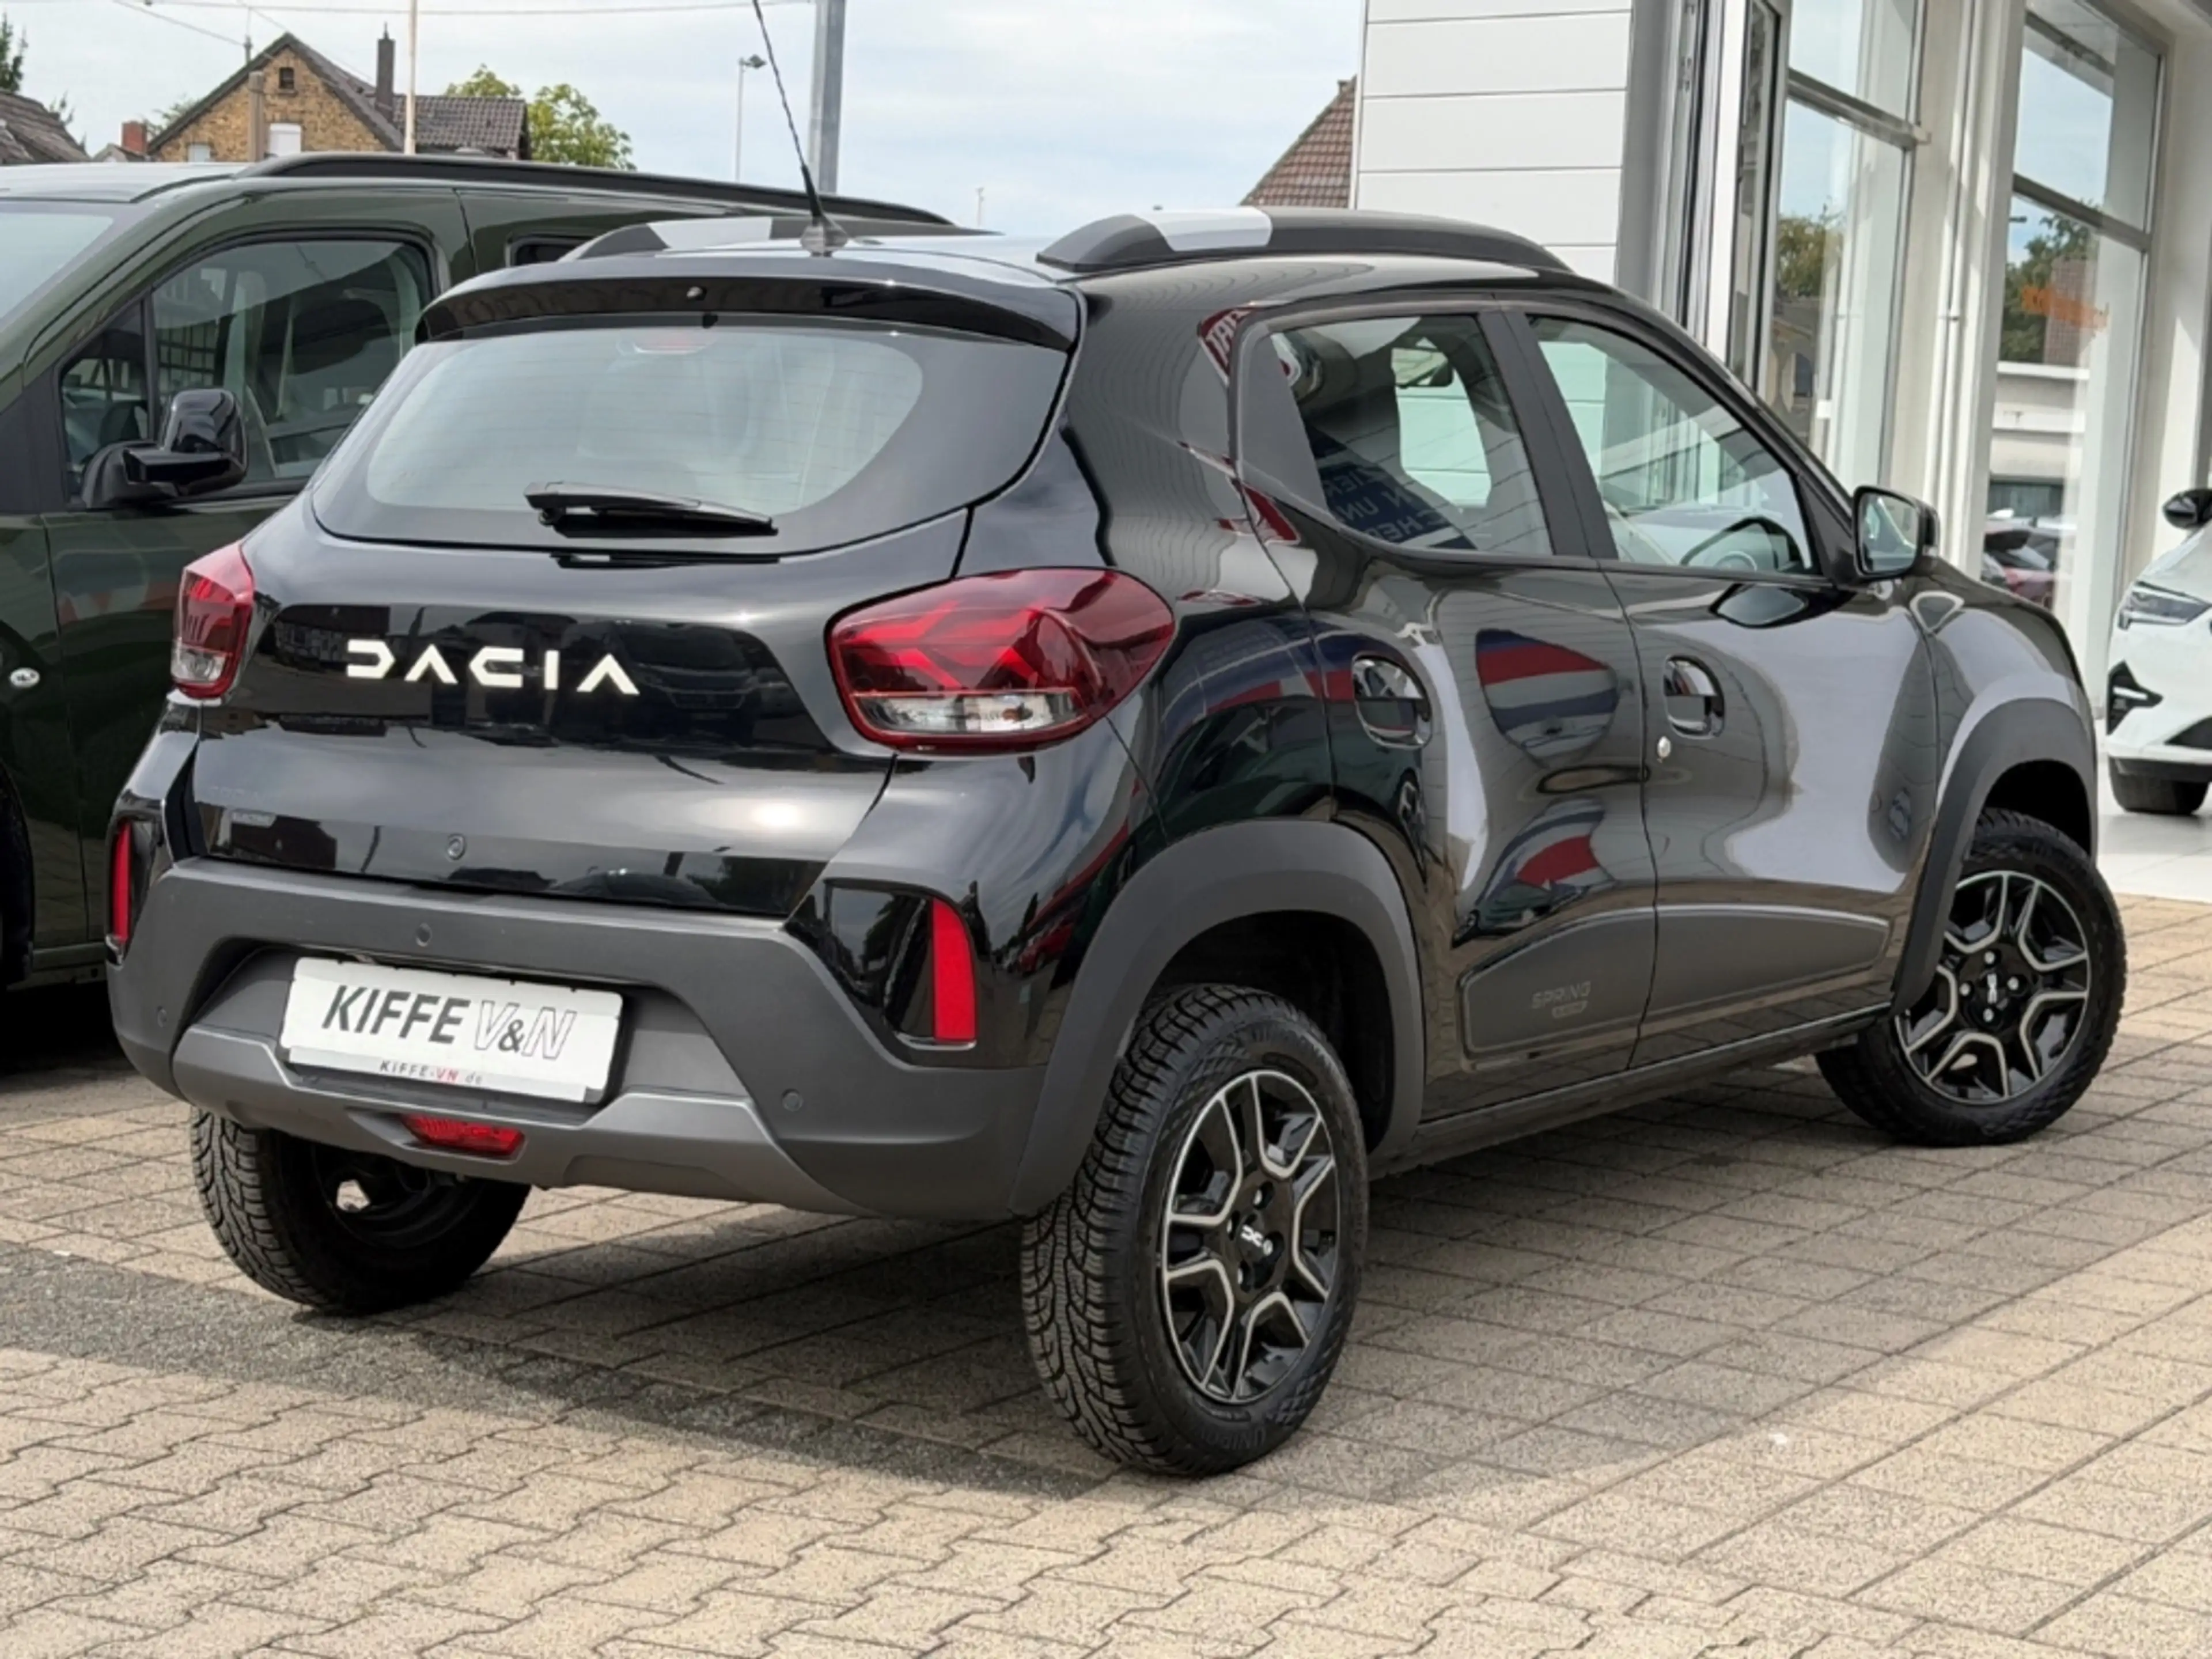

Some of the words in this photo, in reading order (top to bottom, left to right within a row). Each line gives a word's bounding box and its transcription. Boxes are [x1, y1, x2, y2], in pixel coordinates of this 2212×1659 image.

[347, 639, 639, 695] DACIA
[321, 985, 471, 1044] KIFFE
[380, 1060, 483, 1085] KIFFE-VNde
